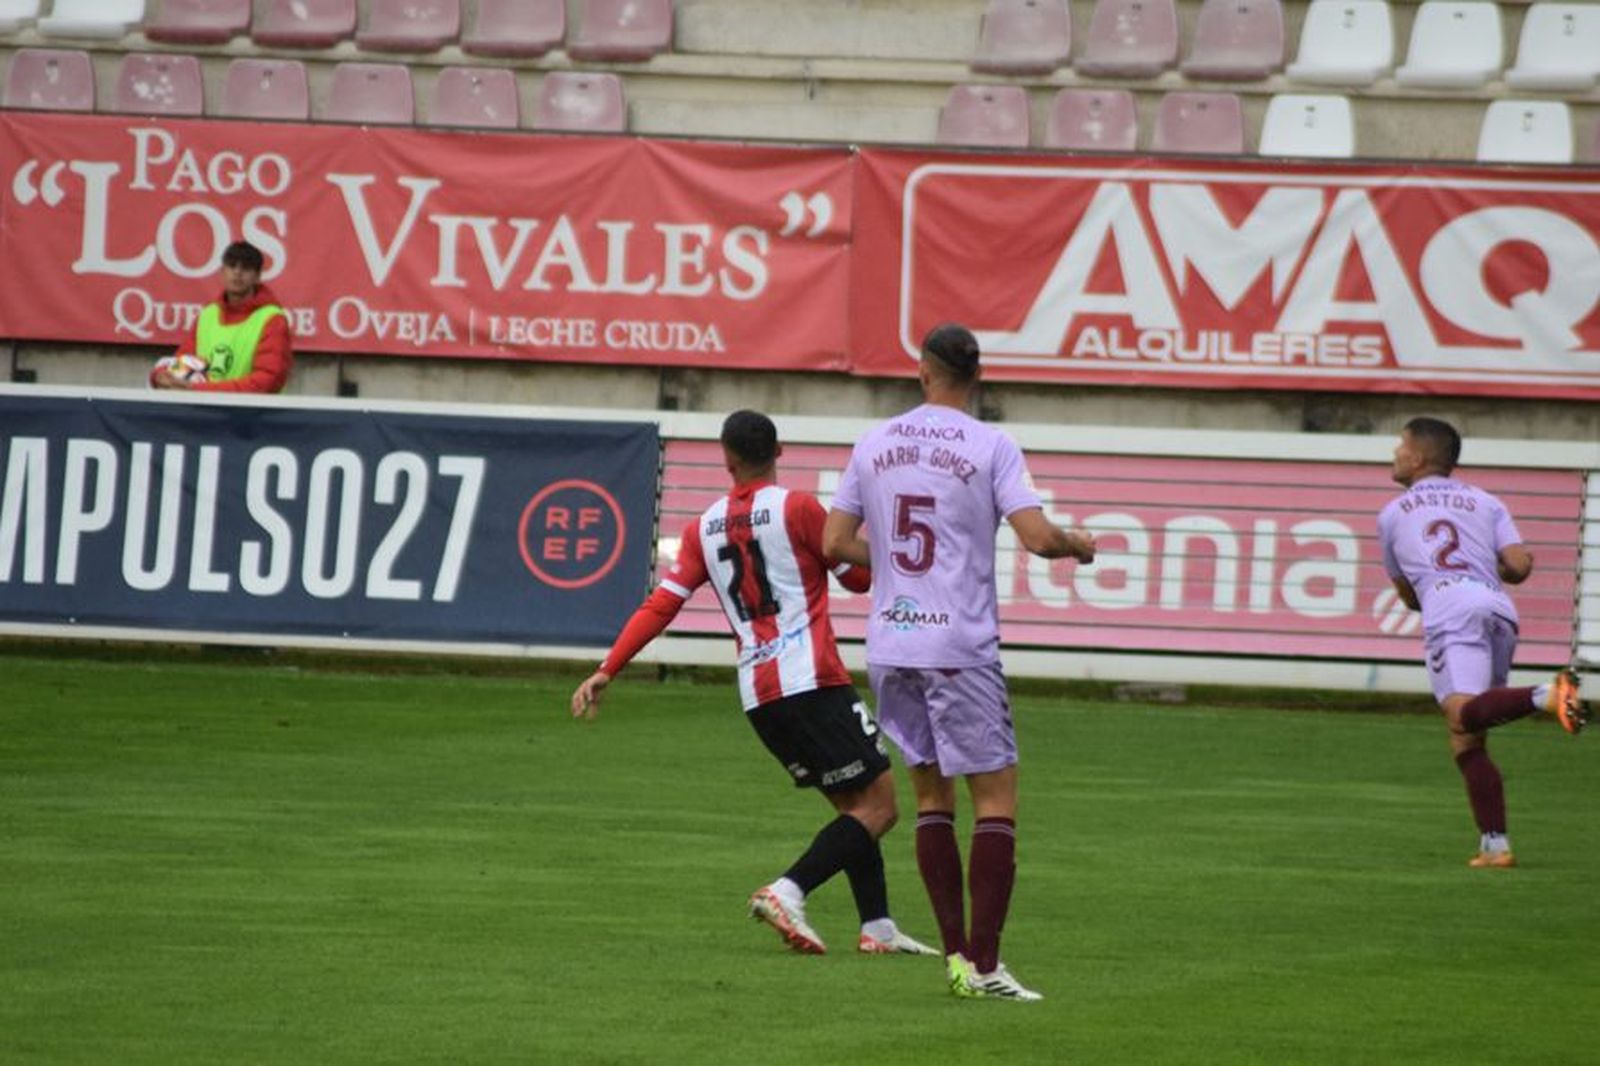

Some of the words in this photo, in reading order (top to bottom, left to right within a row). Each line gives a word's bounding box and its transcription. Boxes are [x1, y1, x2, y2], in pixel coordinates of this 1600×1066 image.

[128, 127, 291, 196] PAGO
[112, 287, 202, 340] QUE
[328, 296, 456, 346] OVEJA
[489, 316, 596, 346] LECHE
[605, 319, 726, 353] CRUDA
[1072, 325, 1385, 367] ALQUILERES
[872, 445, 920, 475] MARIO
[929, 447, 977, 485] GOMEZ
[1400, 493, 1478, 514] BASTOS
[889, 493, 937, 577] 5
[1422, 518, 1471, 572] 2
[717, 539, 781, 622] 21
